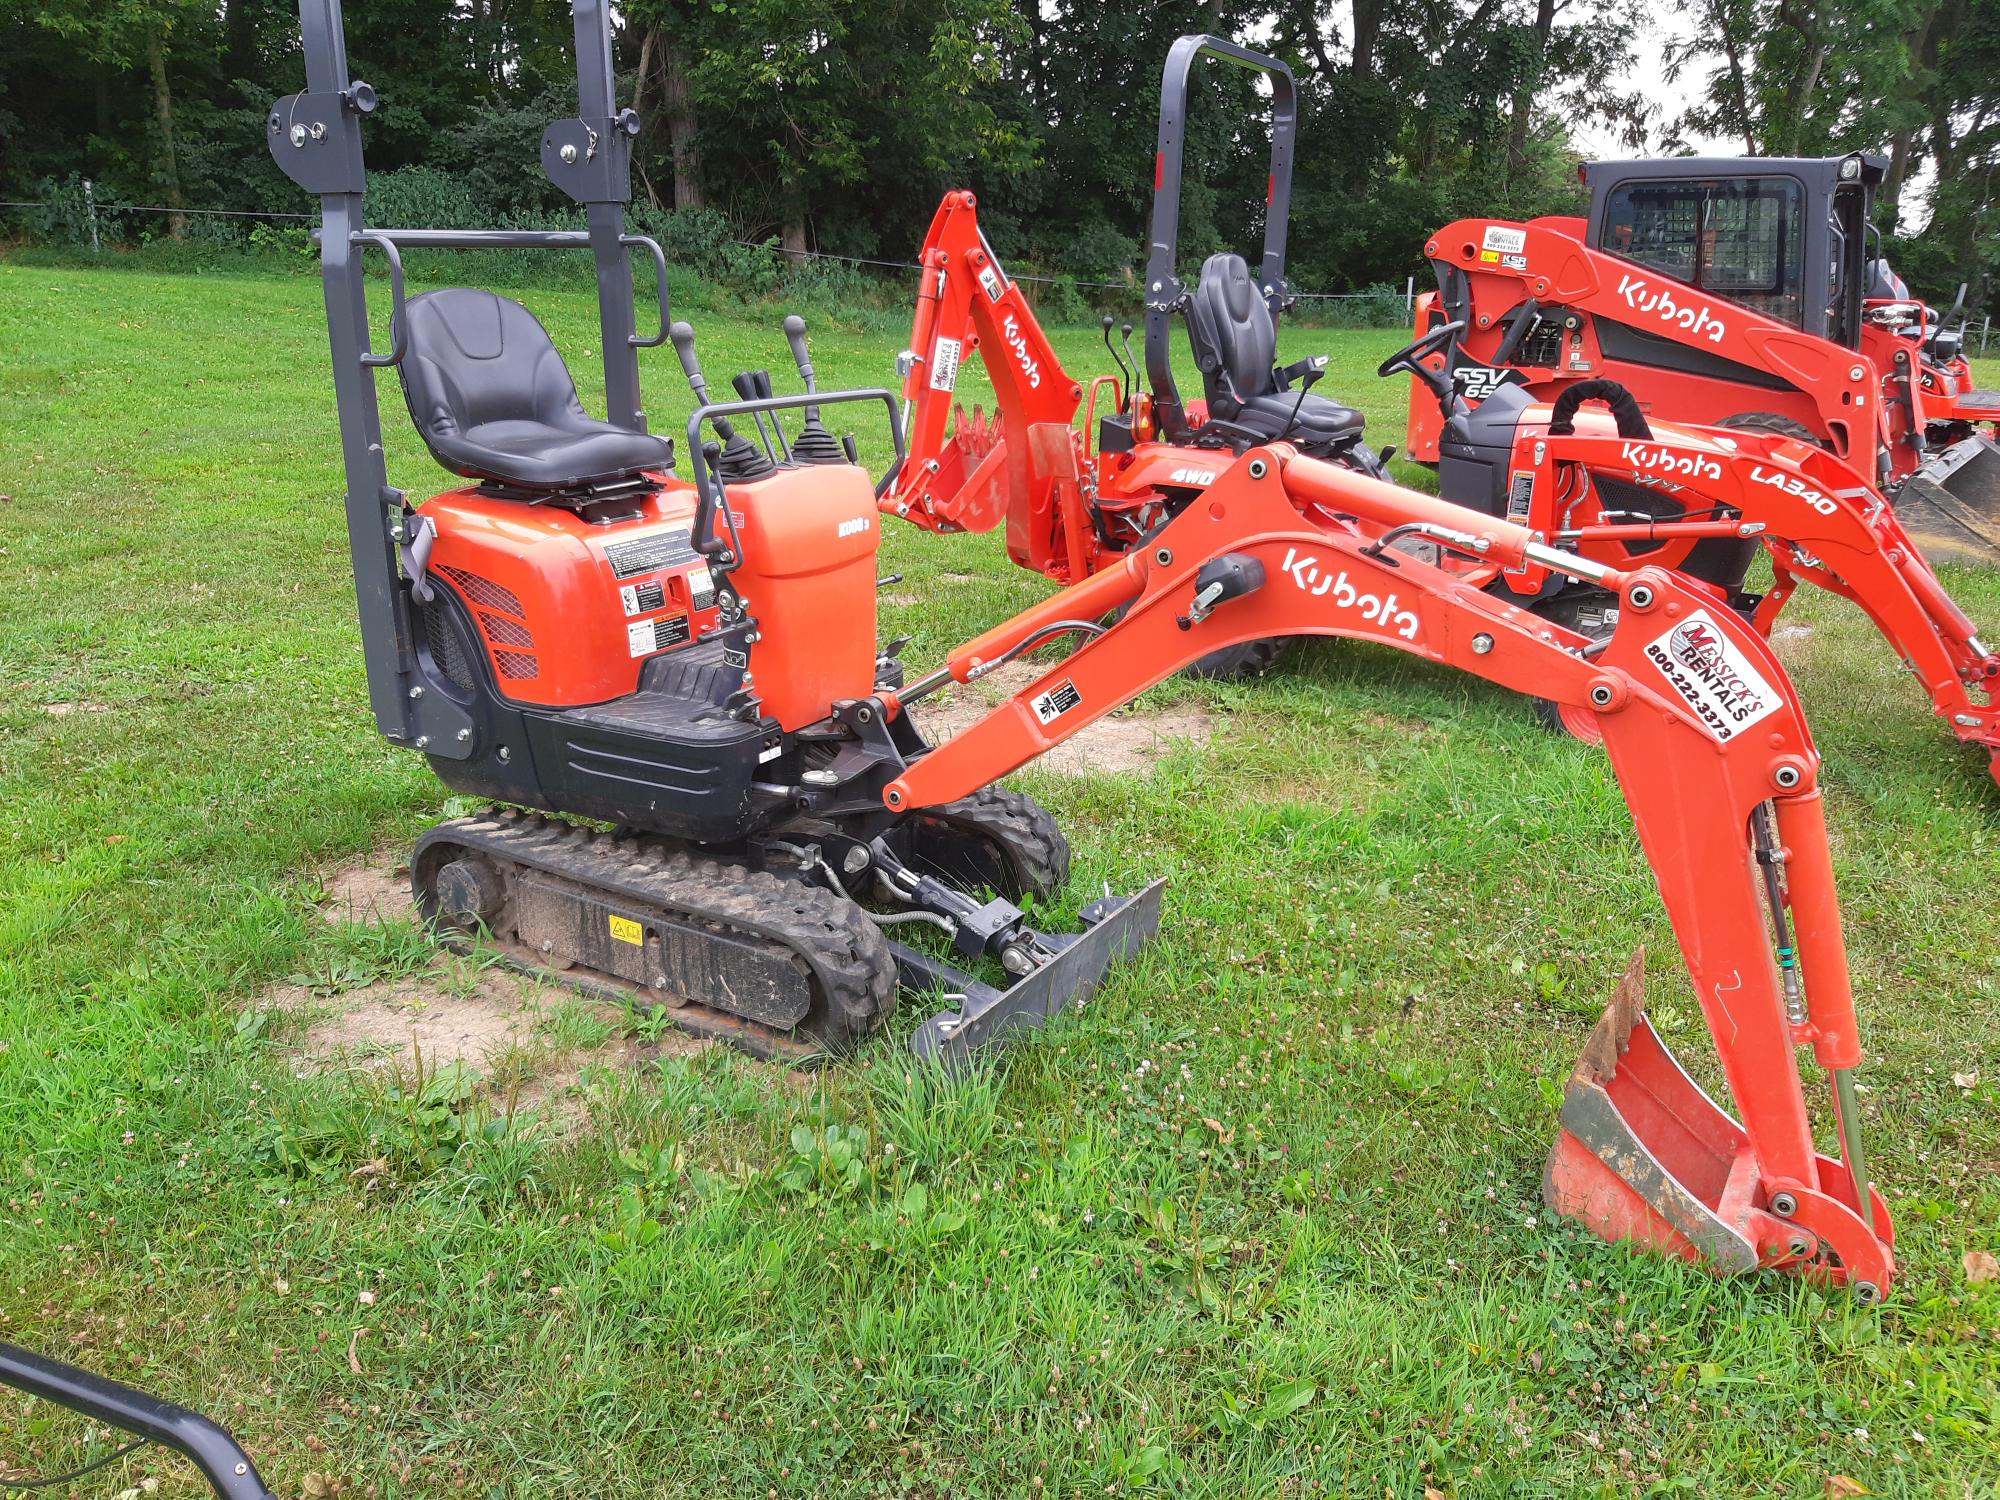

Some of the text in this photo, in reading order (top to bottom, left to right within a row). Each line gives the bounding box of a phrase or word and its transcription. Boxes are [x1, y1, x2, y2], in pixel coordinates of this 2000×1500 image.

[1502, 254, 1527, 265] KSR
[1616, 275, 1726, 343] Kubota
[1004, 314, 1040, 389] Kubota
[1464, 384, 1497, 398] 65
[1170, 468, 1216, 486] 4WD
[1622, 442, 1723, 481] Kubota
[1750, 466, 1838, 516] LA340
[1281, 547, 1419, 640] Kubota
[1647, 644, 1732, 740] 800-222-3373
[1680, 646, 1749, 722] RENTALS
